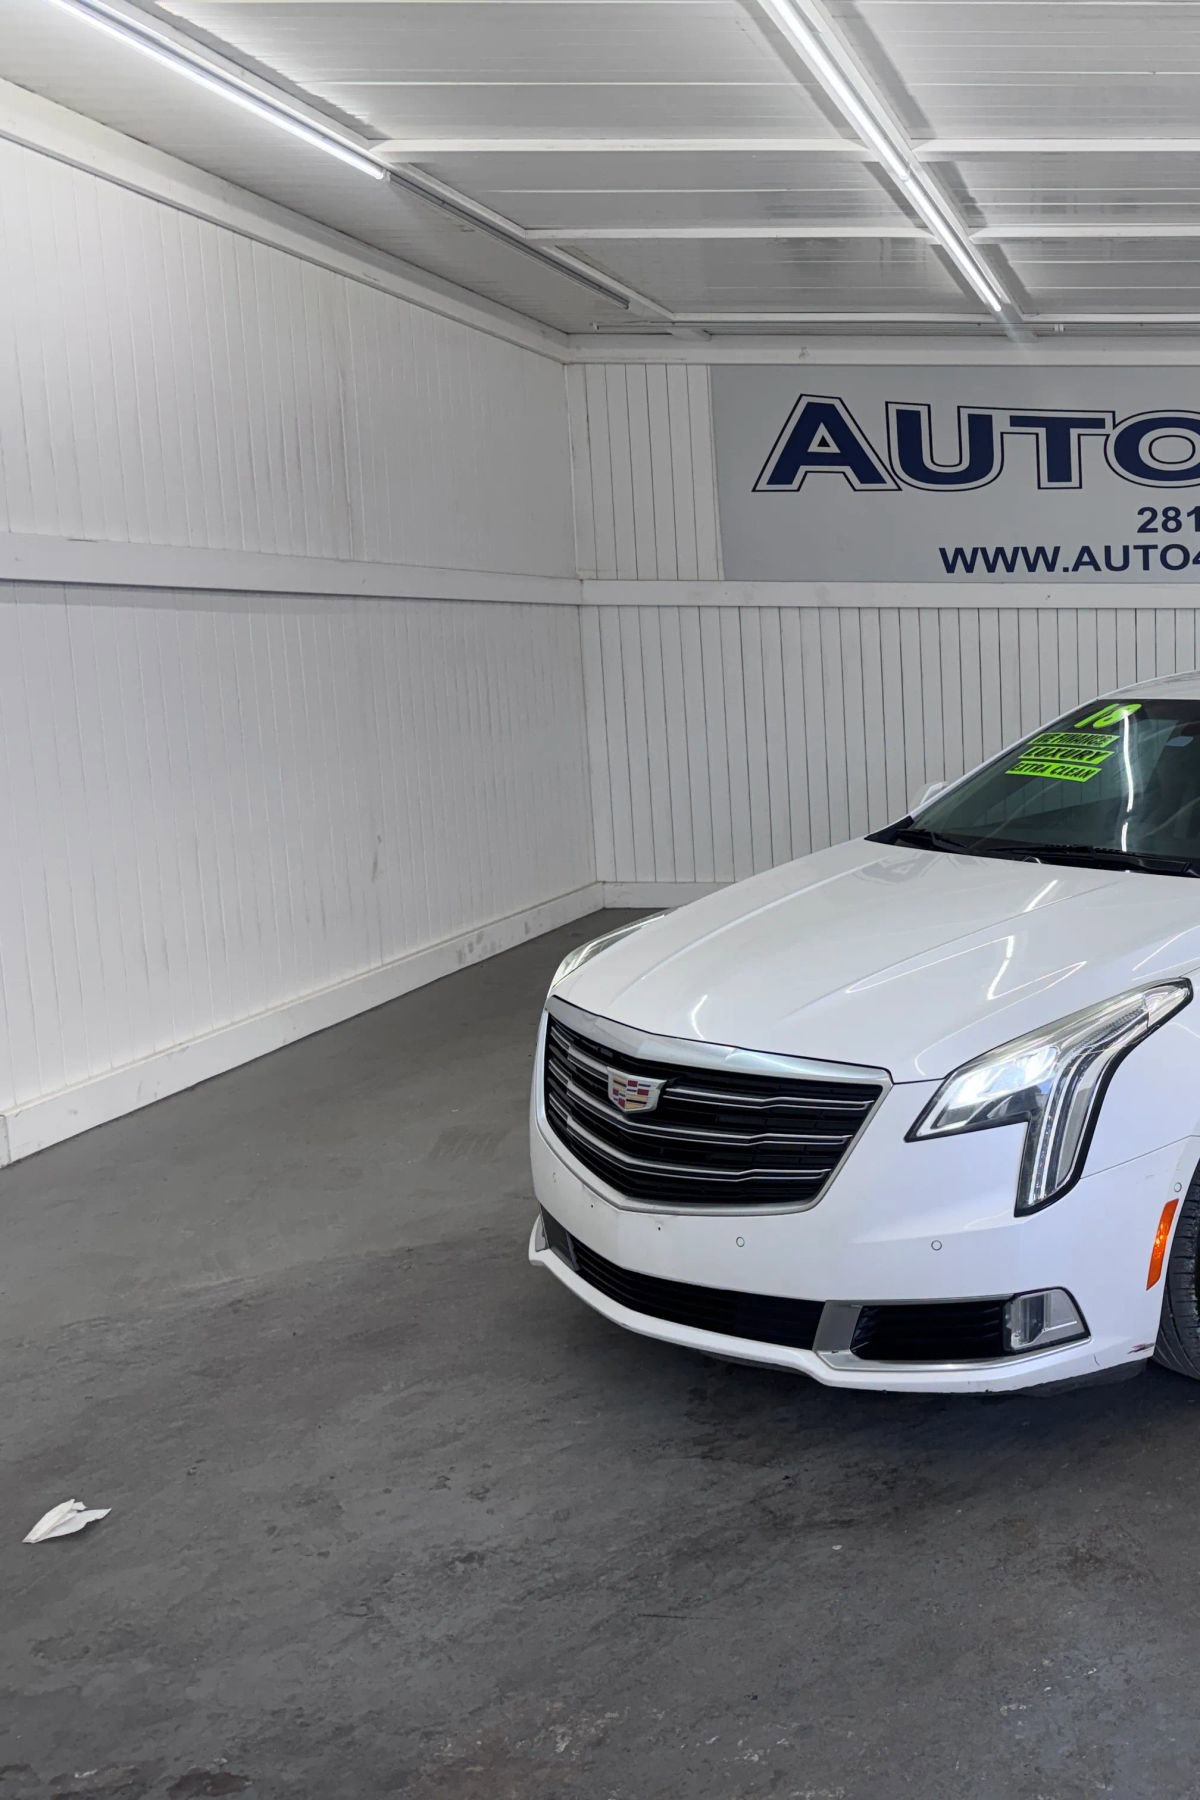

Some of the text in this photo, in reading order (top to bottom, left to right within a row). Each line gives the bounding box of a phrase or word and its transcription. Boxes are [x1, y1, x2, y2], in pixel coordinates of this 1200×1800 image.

[1024, 747, 1107, 761] LUXURY
[1012, 763, 1096, 778] EXTRA CLEAN
